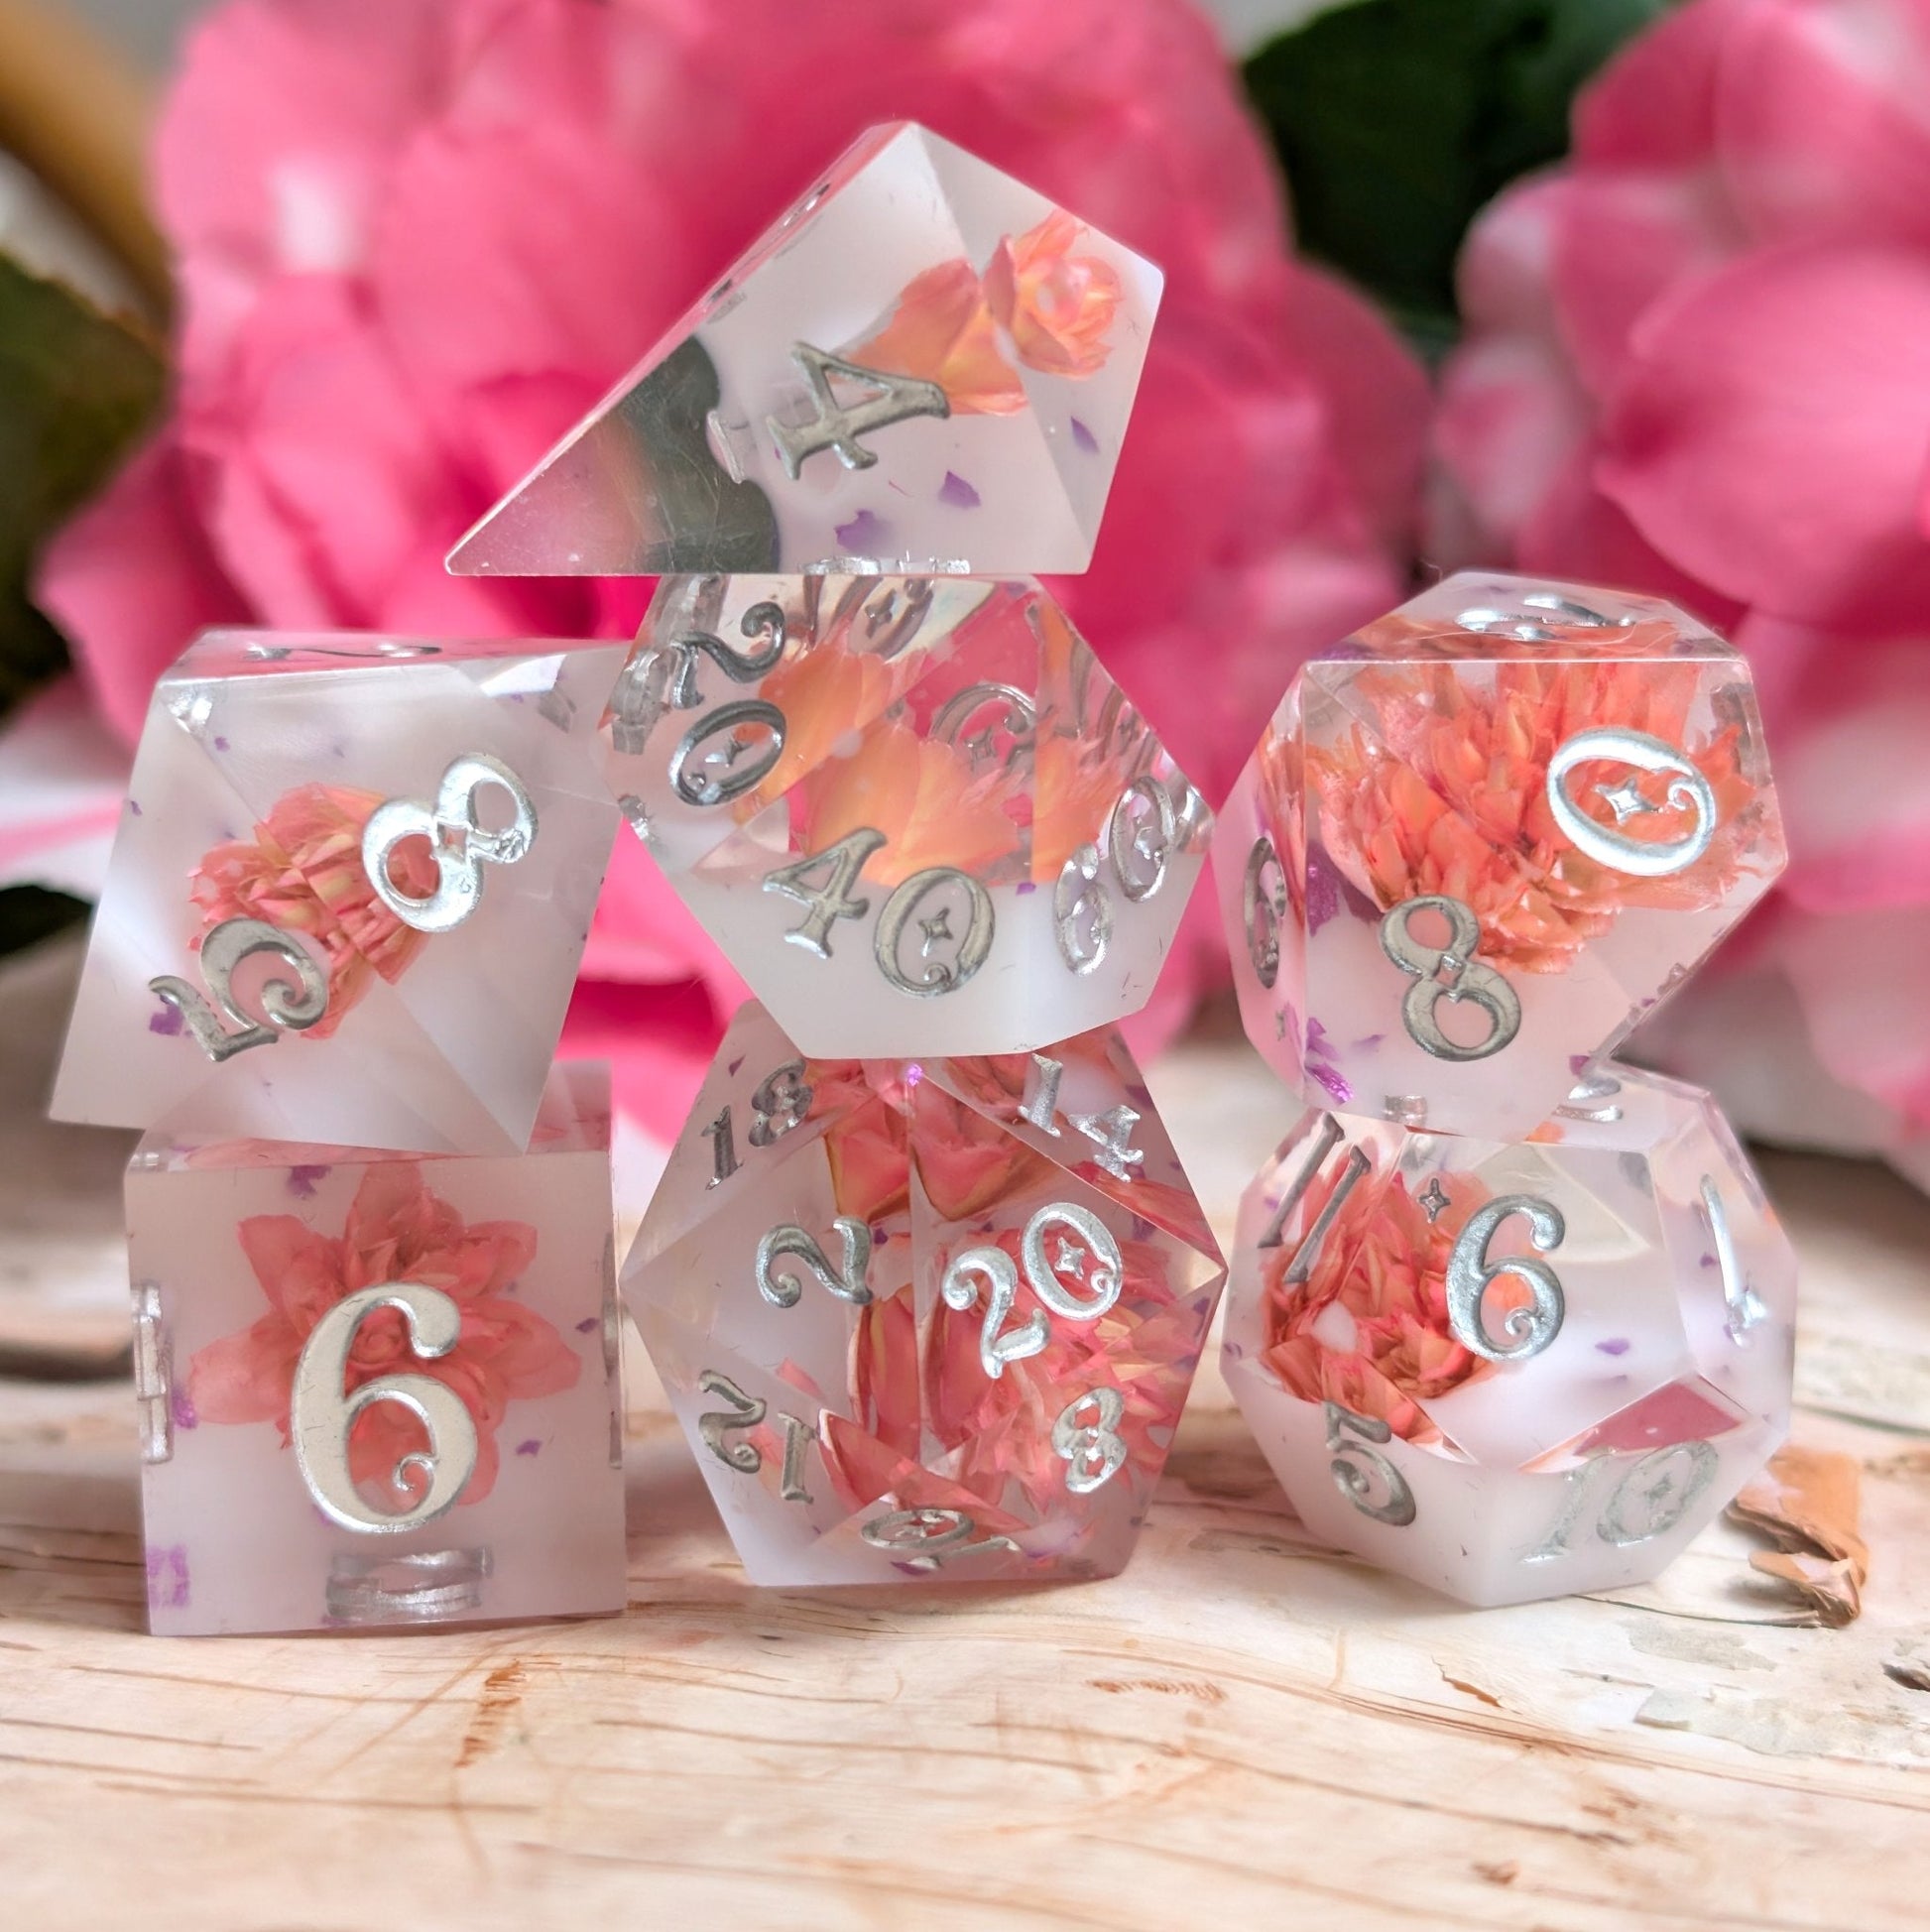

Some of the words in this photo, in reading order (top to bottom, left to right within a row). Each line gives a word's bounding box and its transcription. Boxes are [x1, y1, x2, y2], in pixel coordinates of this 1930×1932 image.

[767, 341, 951, 481] 4
[667, 600, 787, 807] 20
[363, 752, 539, 932] 8
[763, 827, 996, 998] 40
[149, 917, 329, 1062] 5
[1381, 895, 1520, 1062] 8
[700, 1058, 813, 1190] 18
[1018, 1052, 1145, 1182] 14
[1258, 1113, 1371, 1284] 11
[943, 1202, 1124, 1379] 20
[292, 1280, 479, 1534] 6
[1052, 1388, 1128, 1493] 8
[1320, 1399, 1417, 1526] 5
[1518, 1439, 1721, 1563] 10
